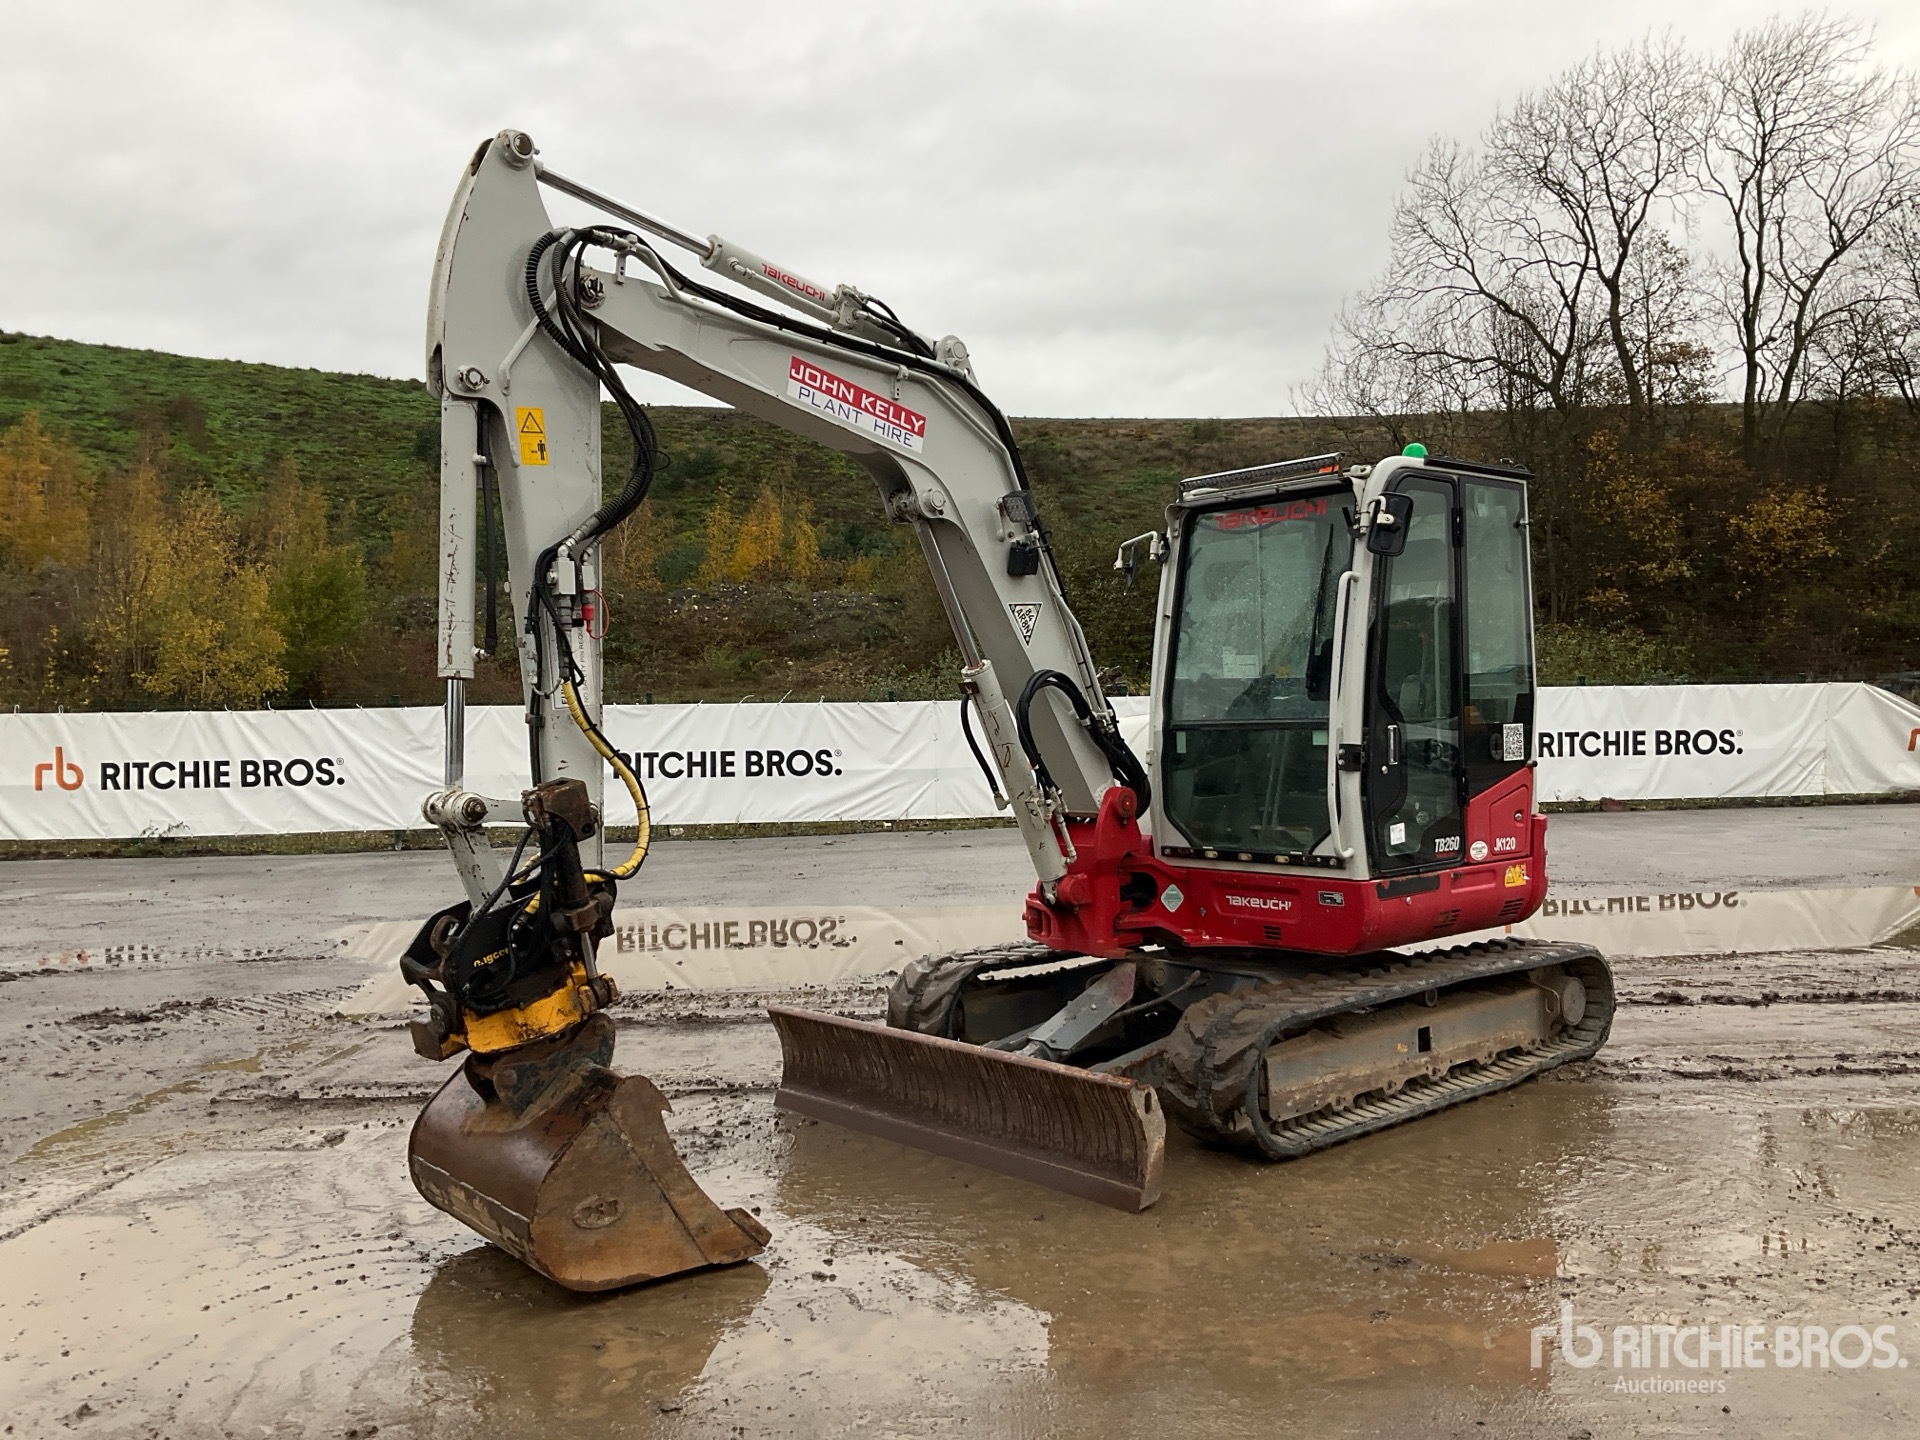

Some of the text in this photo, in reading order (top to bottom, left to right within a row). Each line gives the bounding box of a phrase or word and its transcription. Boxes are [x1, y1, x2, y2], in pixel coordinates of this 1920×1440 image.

[790, 363, 926, 432] JOHN KELLY
[798, 386, 915, 449] PLANT HIRE
[580, 664, 589, 690] SATY
[1538, 730, 1646, 757] RITCHIE
[35, 746, 84, 791] rb
[101, 760, 230, 790] RITCHIE
[1434, 836, 1460, 853] TB260
[1493, 836, 1516, 852] JK120
